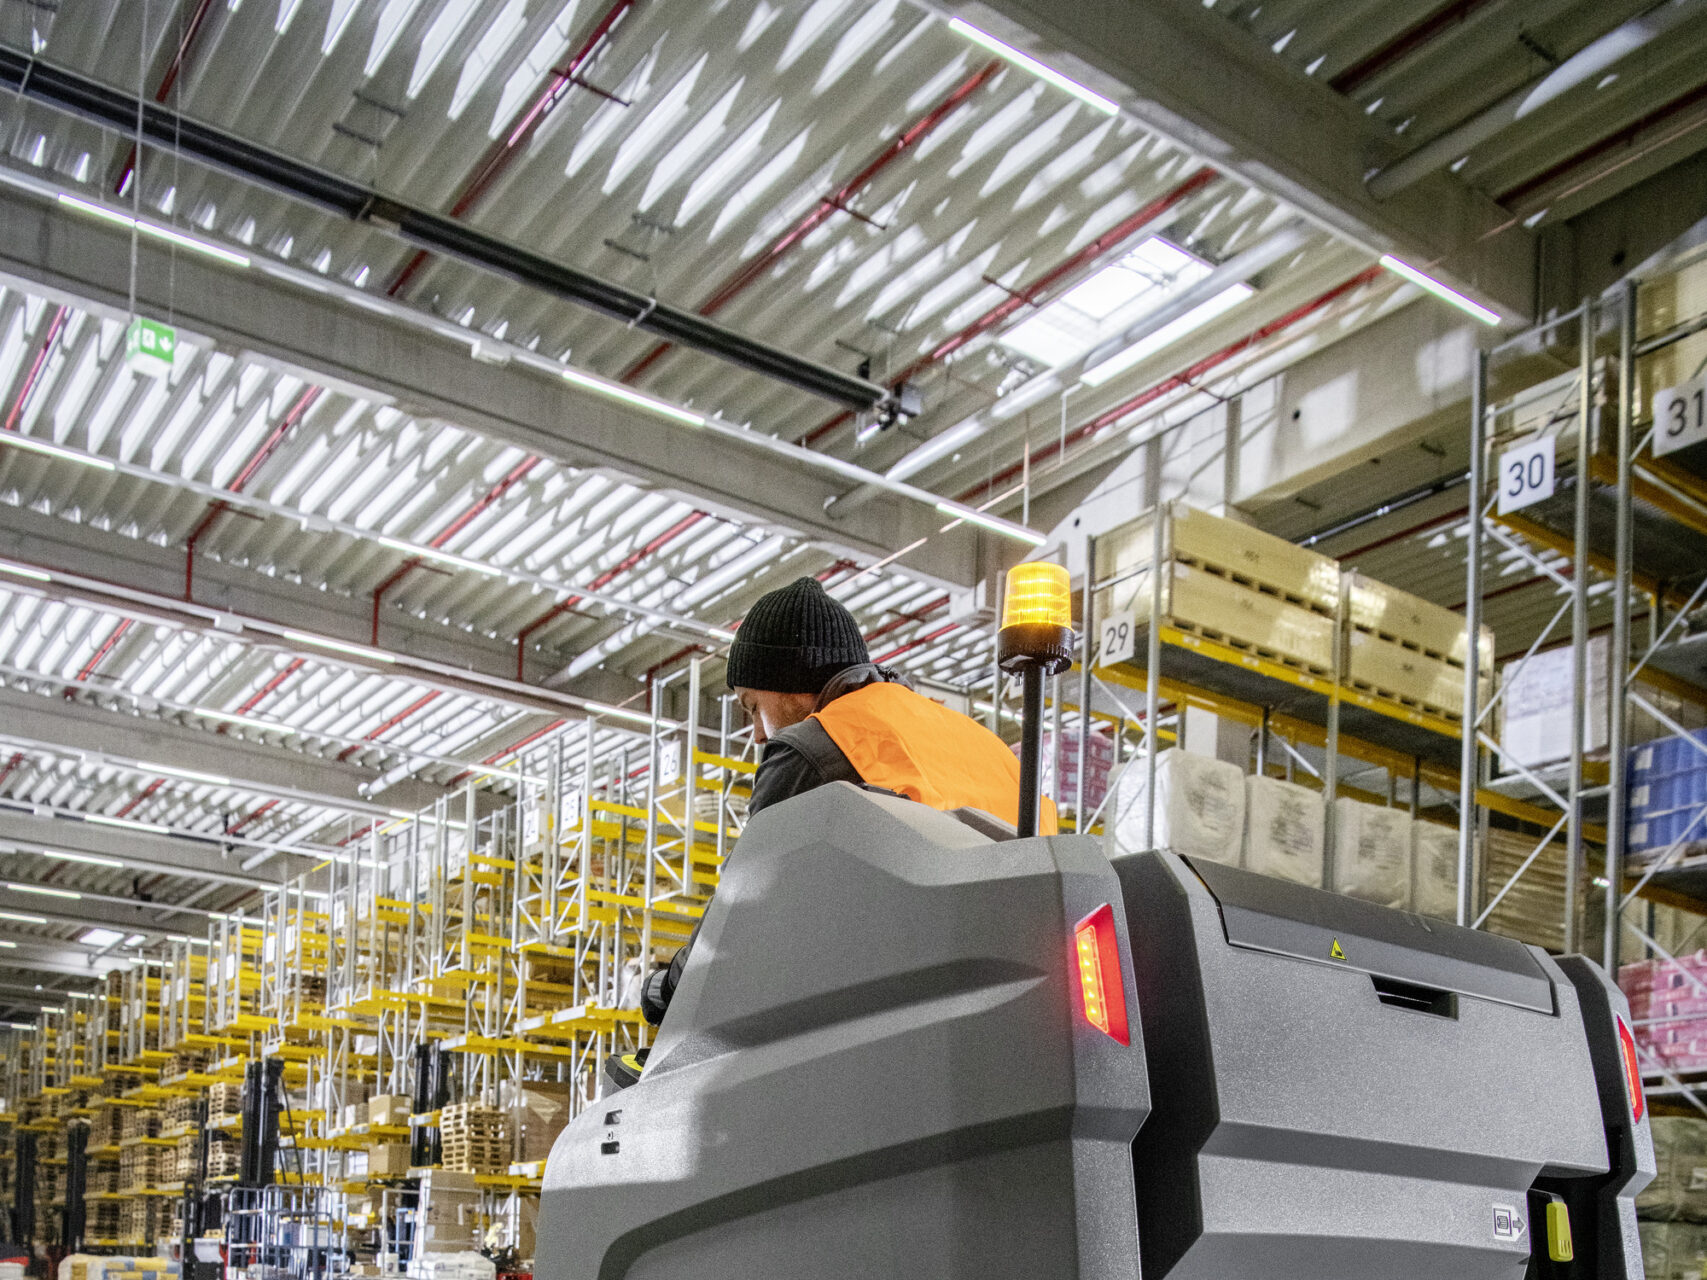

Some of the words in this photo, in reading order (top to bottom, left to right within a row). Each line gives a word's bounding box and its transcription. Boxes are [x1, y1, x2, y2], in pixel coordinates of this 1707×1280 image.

[1667, 388, 1705, 437] 31
[1508, 453, 1545, 497] 30
[1106, 621, 1129, 656] 29
[664, 750, 677, 776] 26
